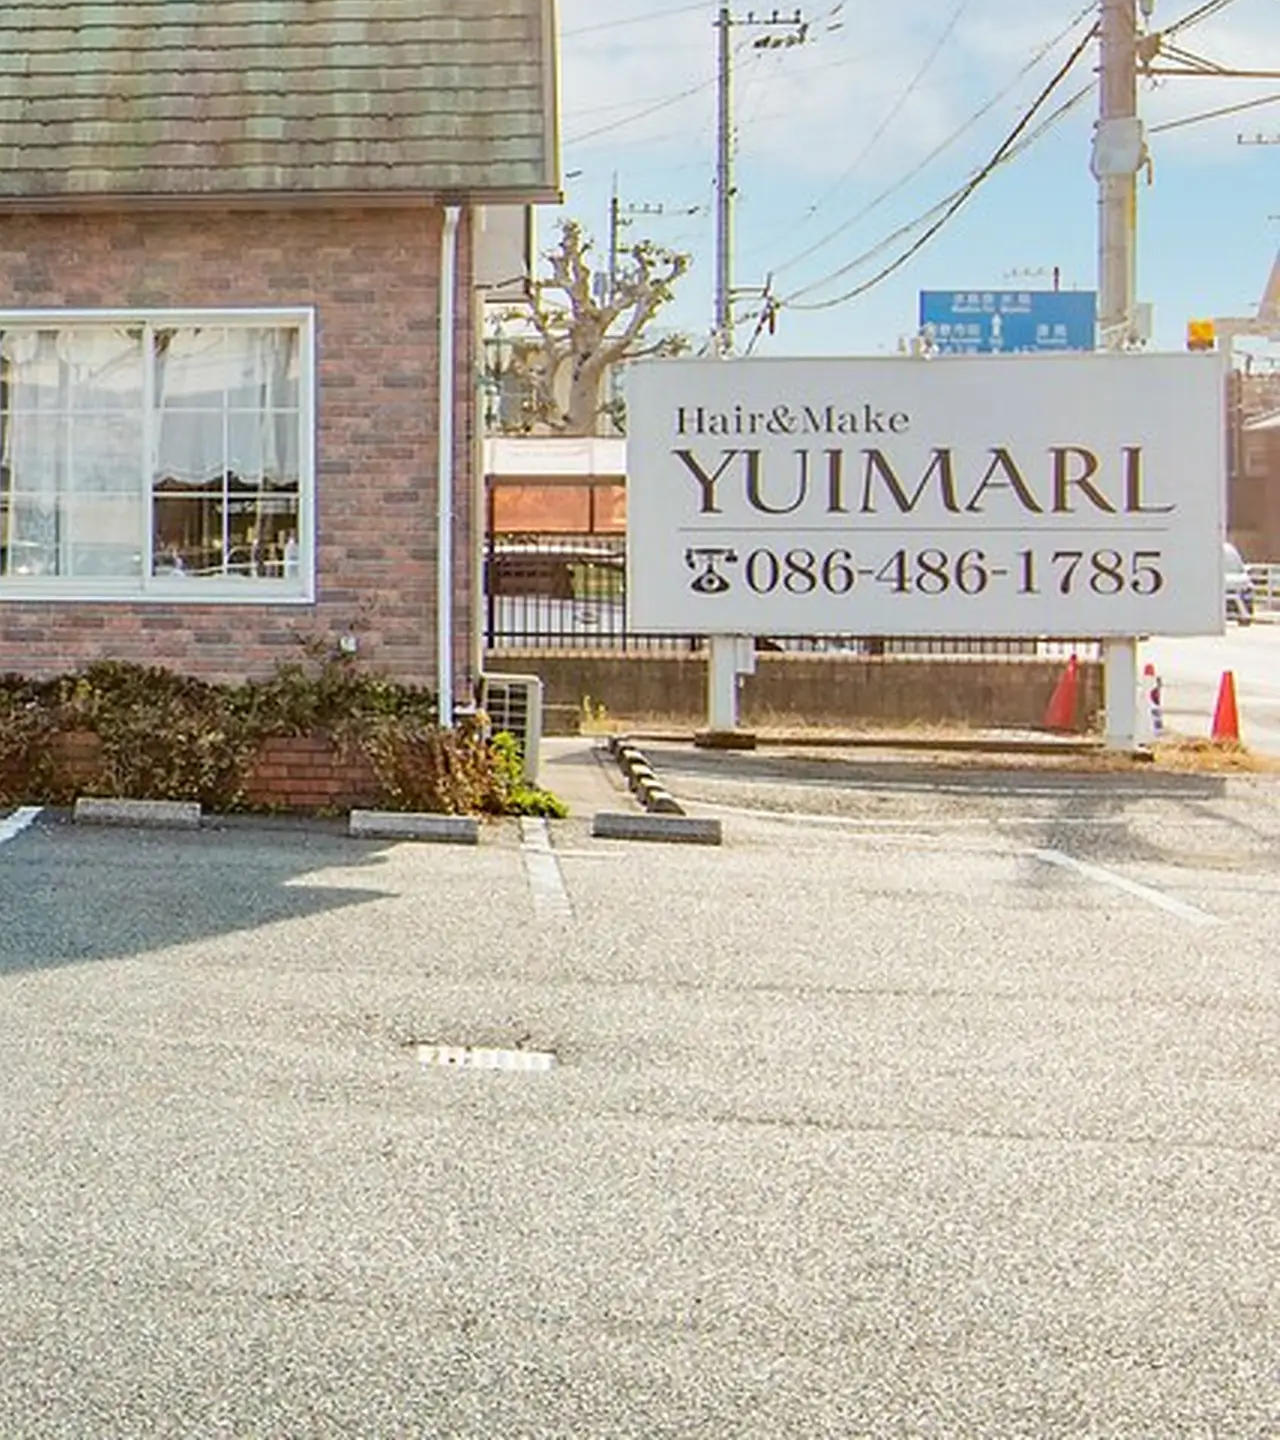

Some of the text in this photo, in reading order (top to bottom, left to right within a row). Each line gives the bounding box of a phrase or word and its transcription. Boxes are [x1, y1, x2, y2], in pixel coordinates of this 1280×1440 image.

[677, 403, 910, 436] Hair&Make
[670, 446, 1177, 515] YUIMARL
[744, 548, 1164, 596] 086-486-1785
